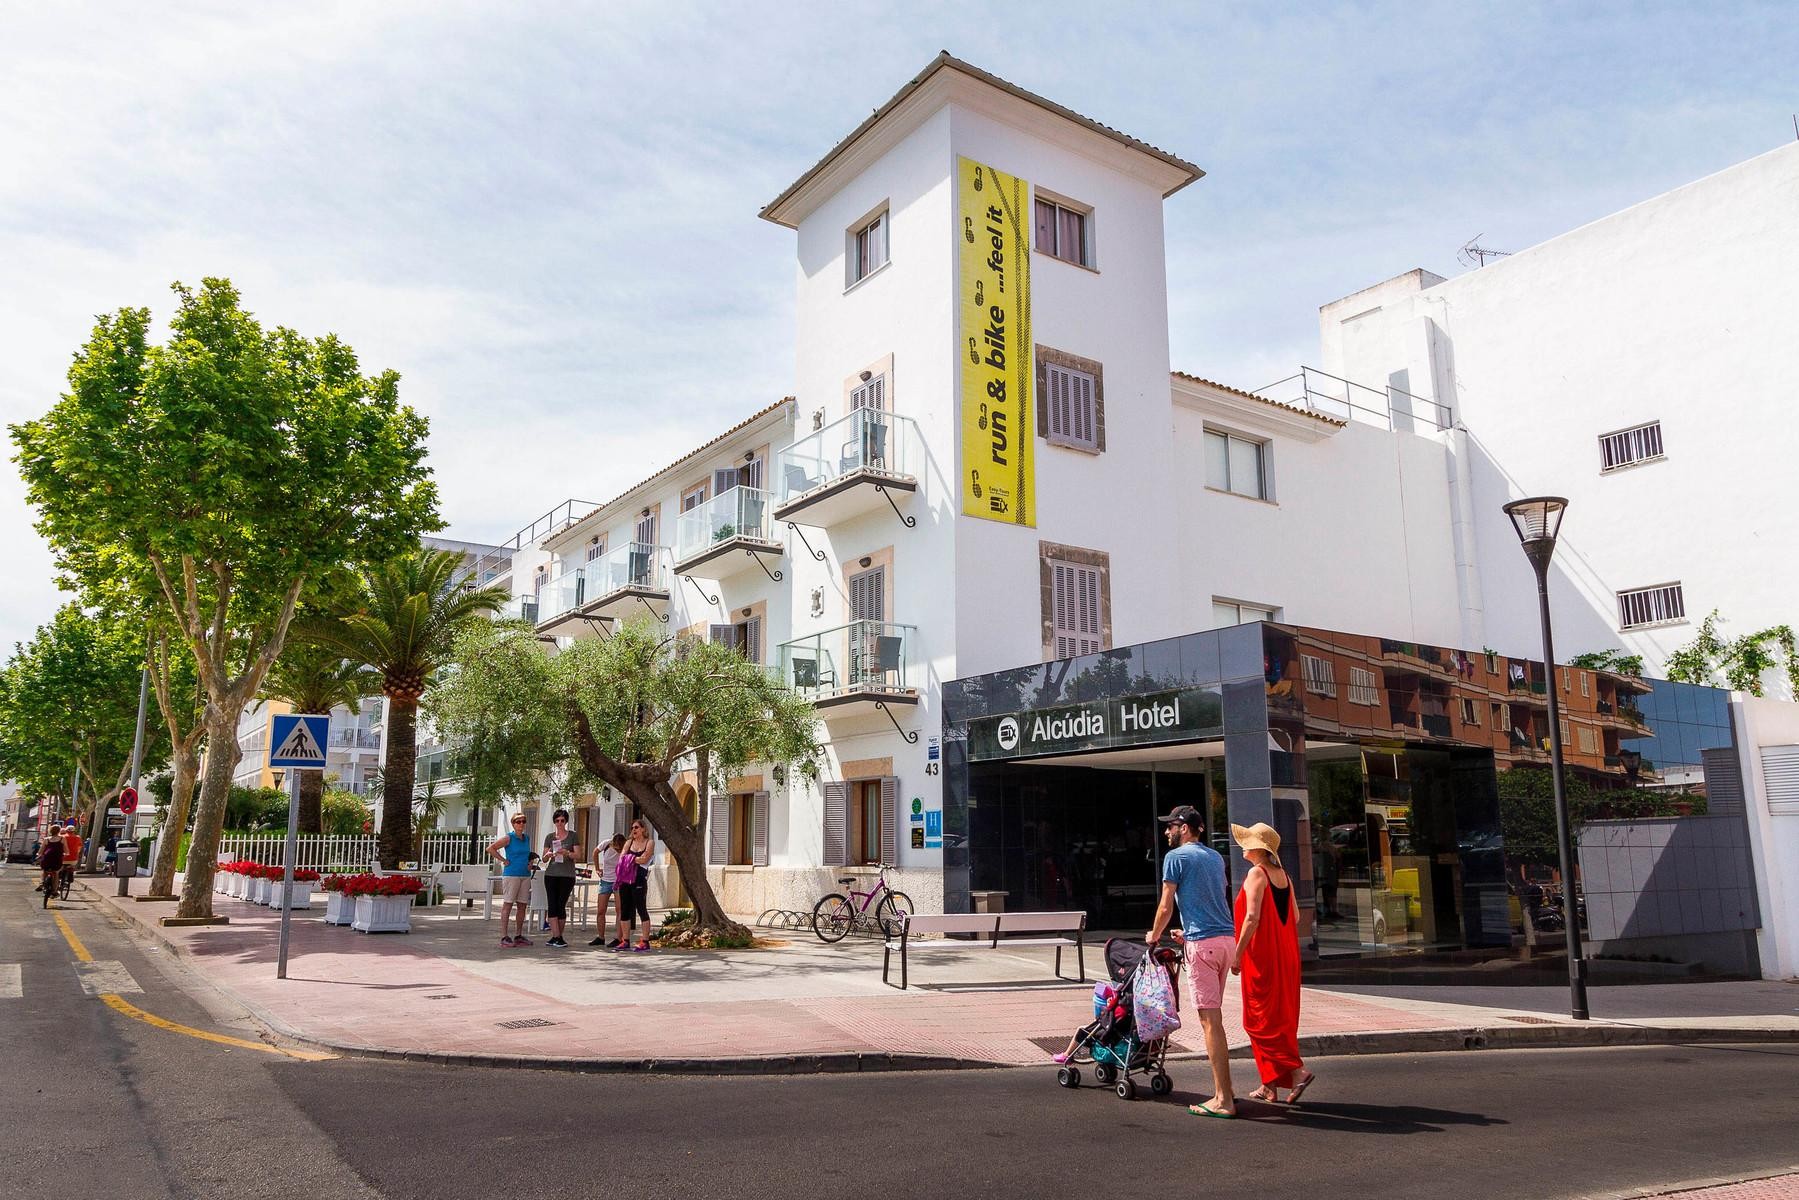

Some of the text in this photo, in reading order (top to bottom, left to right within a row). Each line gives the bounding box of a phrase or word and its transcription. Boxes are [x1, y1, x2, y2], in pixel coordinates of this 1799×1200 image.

[984, 204, 1008, 467] run & bike ...feel it
[1031, 709, 1104, 742] Alcúdia
[1120, 697, 1180, 732] Hotel
[925, 763, 939, 776] 43
